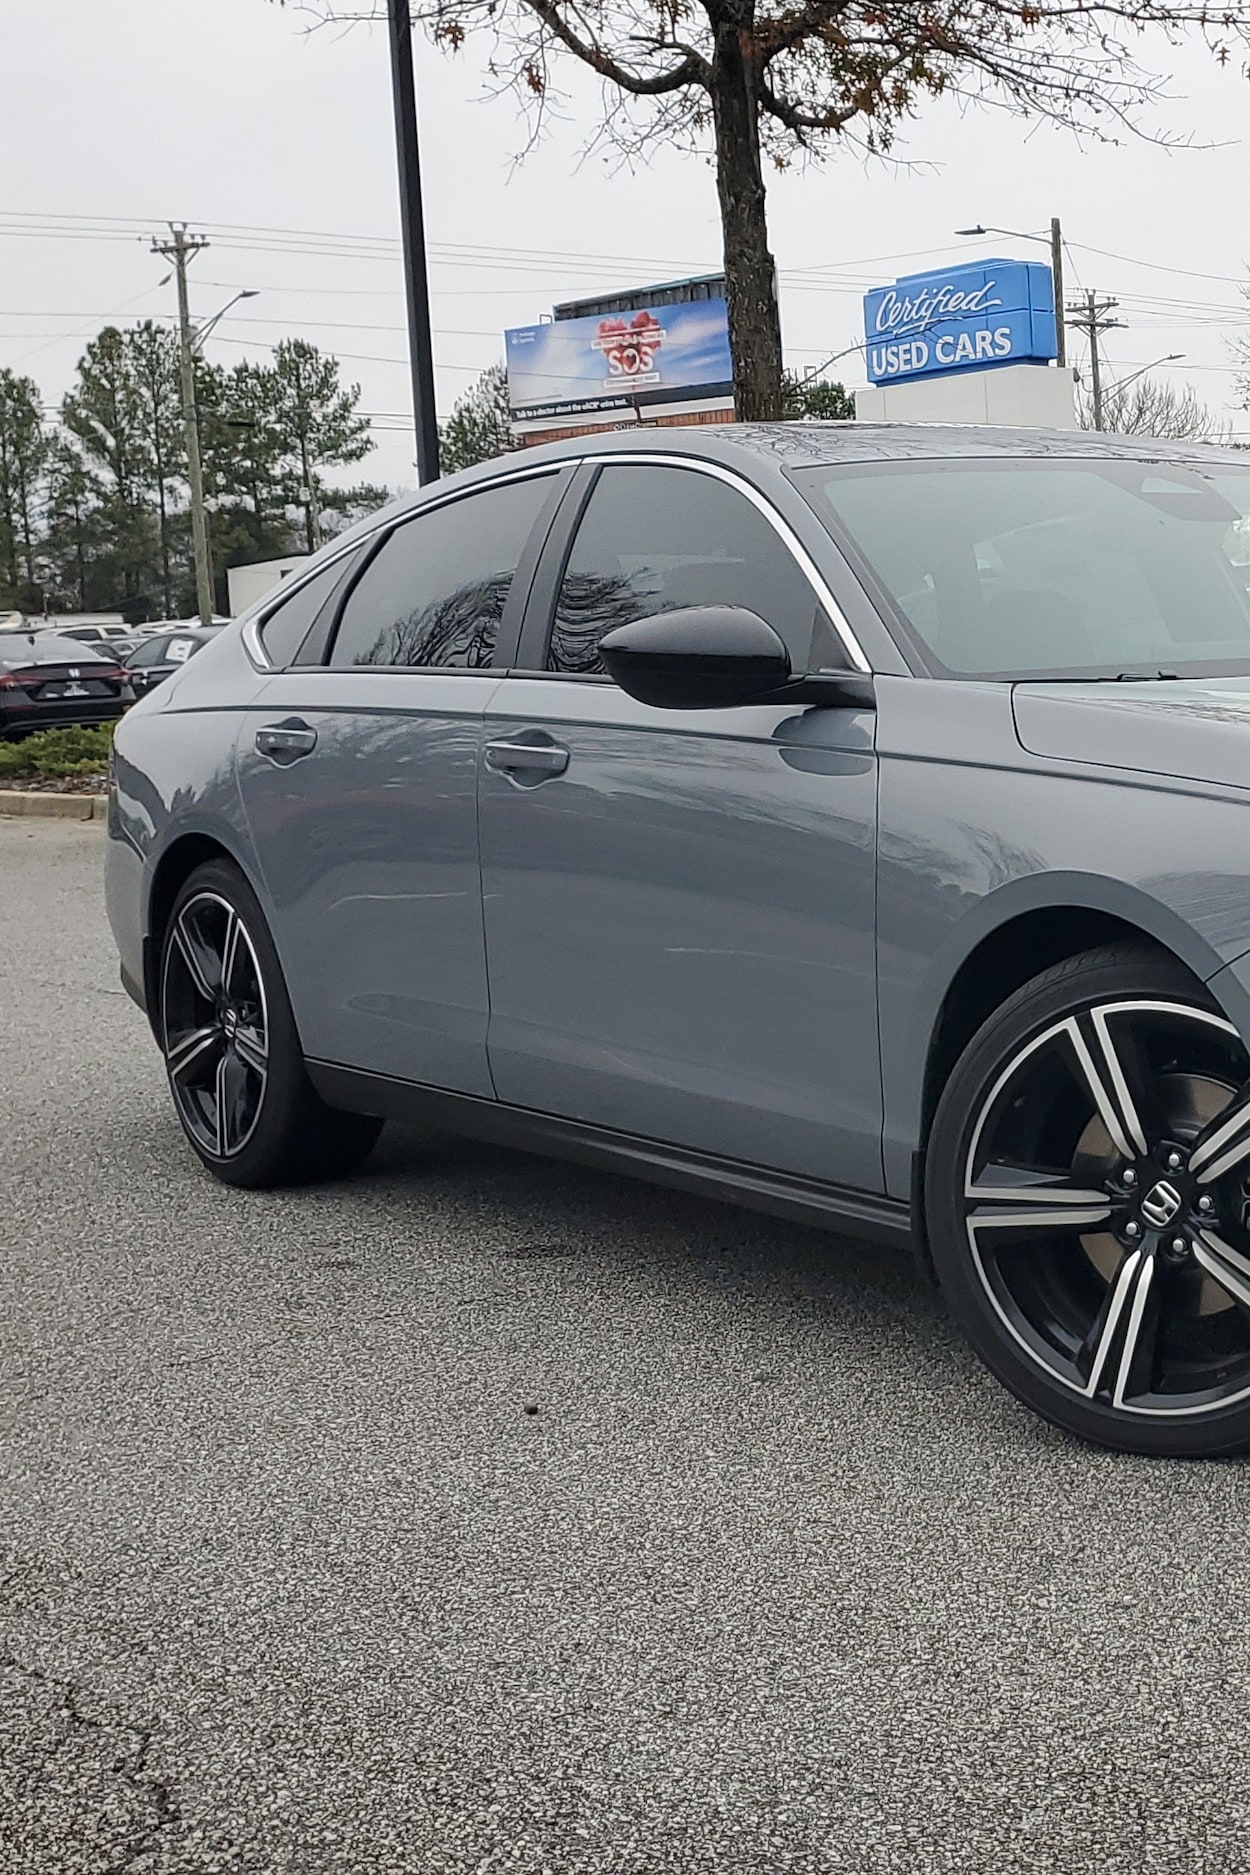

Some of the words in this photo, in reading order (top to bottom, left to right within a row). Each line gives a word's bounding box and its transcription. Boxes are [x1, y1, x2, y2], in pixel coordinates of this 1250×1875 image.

[876, 281, 1003, 335] Certified
[608, 346, 654, 375] SOS
[872, 341, 929, 377] USED
[935, 327, 1011, 364] CARS
